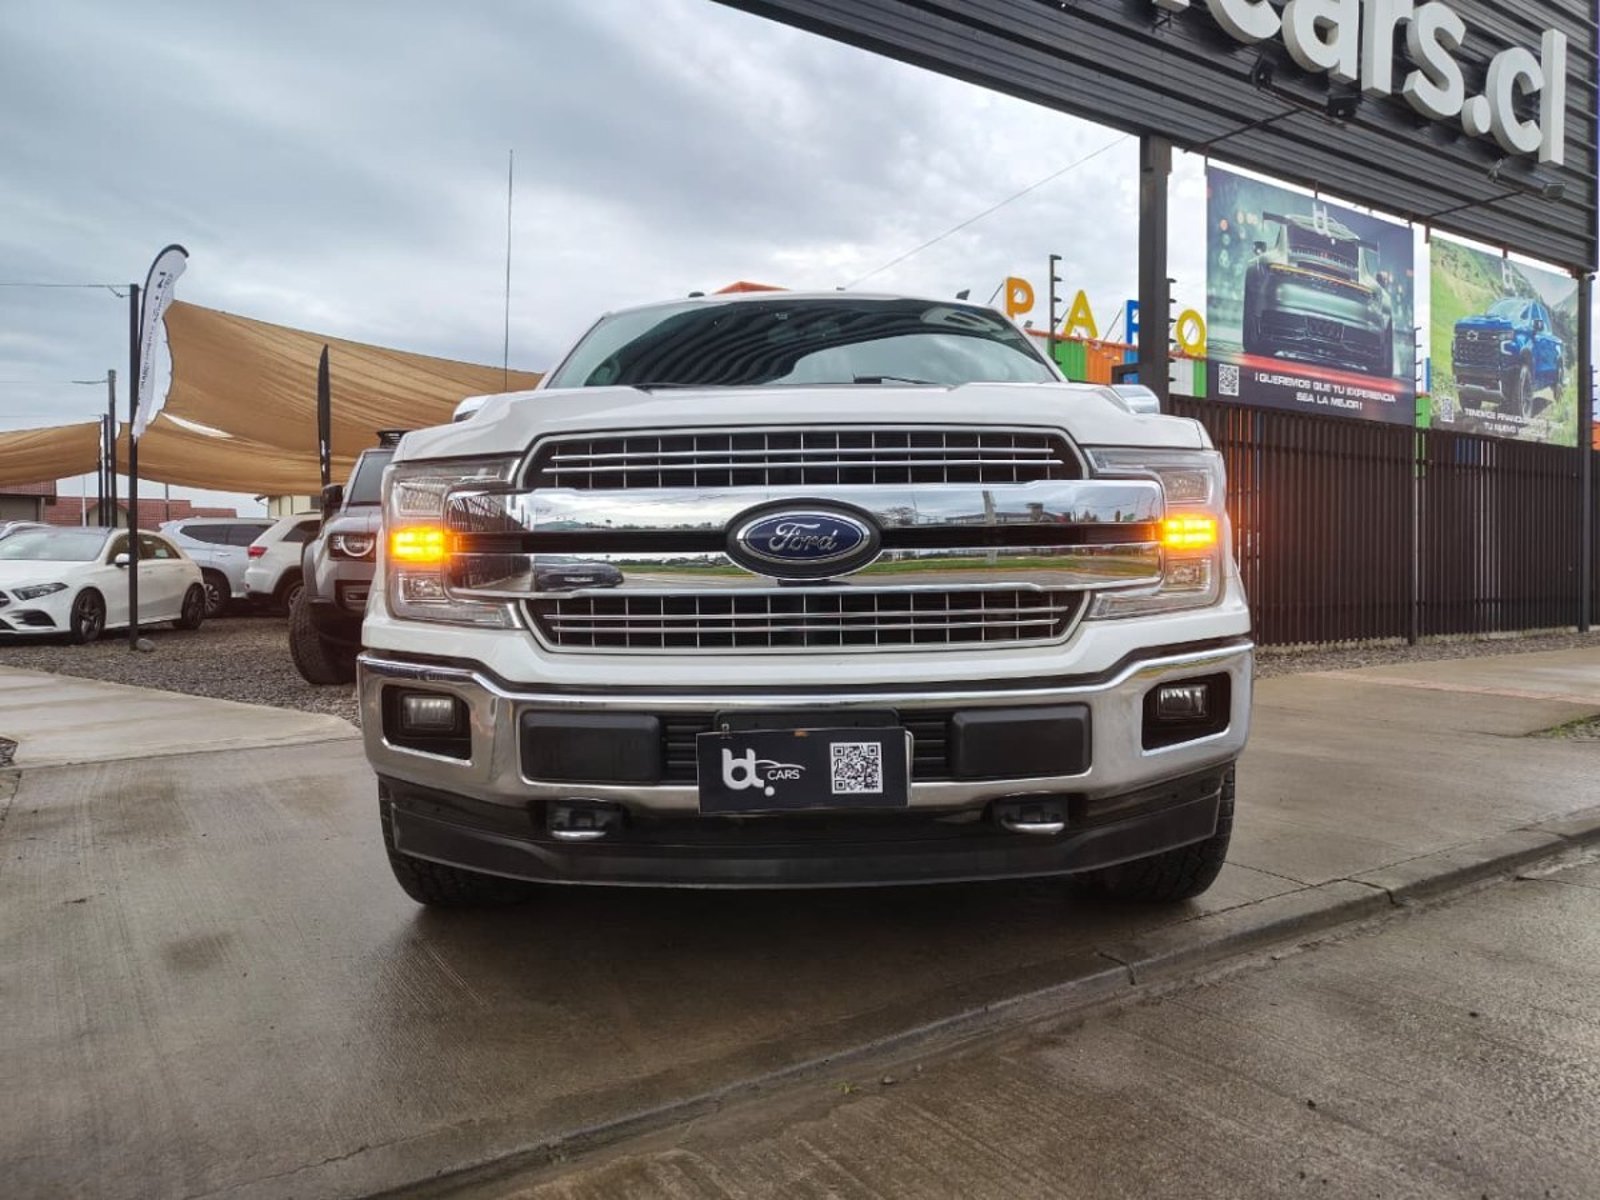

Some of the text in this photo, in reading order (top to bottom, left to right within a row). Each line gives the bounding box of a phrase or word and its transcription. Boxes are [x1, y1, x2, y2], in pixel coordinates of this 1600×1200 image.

[1313, 381, 1331, 392] QUE
[1333, 384, 1345, 395] TU
[1347, 387, 1396, 402] EXPERIENCIA
[1317, 395, 1330, 405] LA
[768, 522, 838, 551] Ford
[767, 769, 800, 780] CARS
